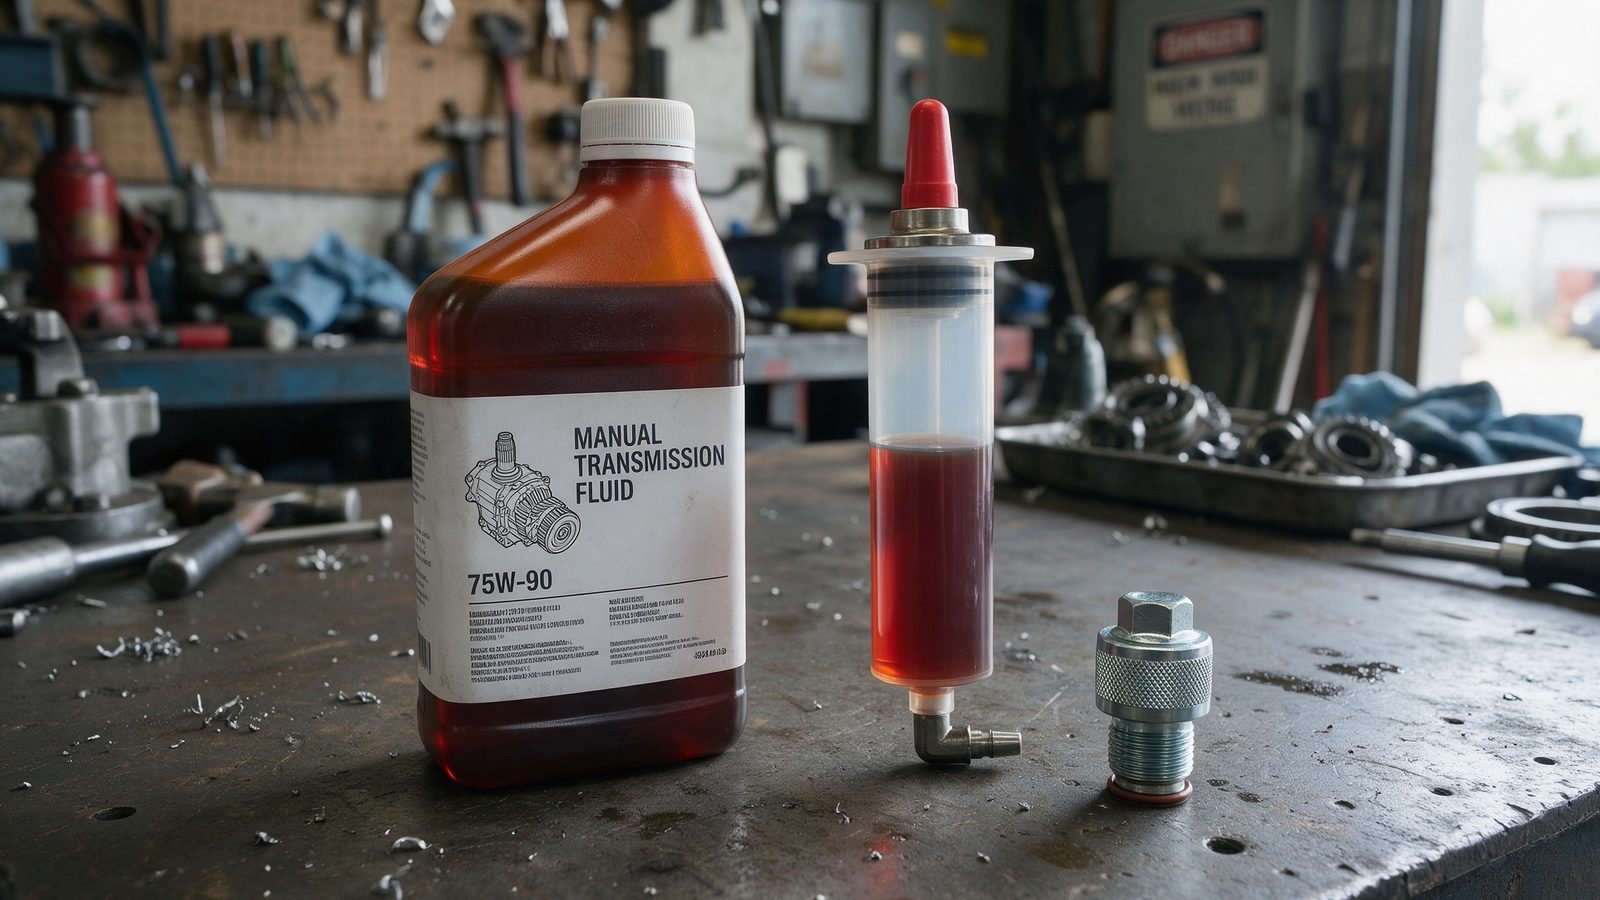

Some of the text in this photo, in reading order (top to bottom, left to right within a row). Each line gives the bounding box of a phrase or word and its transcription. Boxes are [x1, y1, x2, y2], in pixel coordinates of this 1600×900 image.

[574, 423, 662, 449] MANUAL
[574, 444, 725, 477] TRANSMISSION
[575, 479, 634, 504] FLUID
[468, 569, 552, 595] 75W-90
